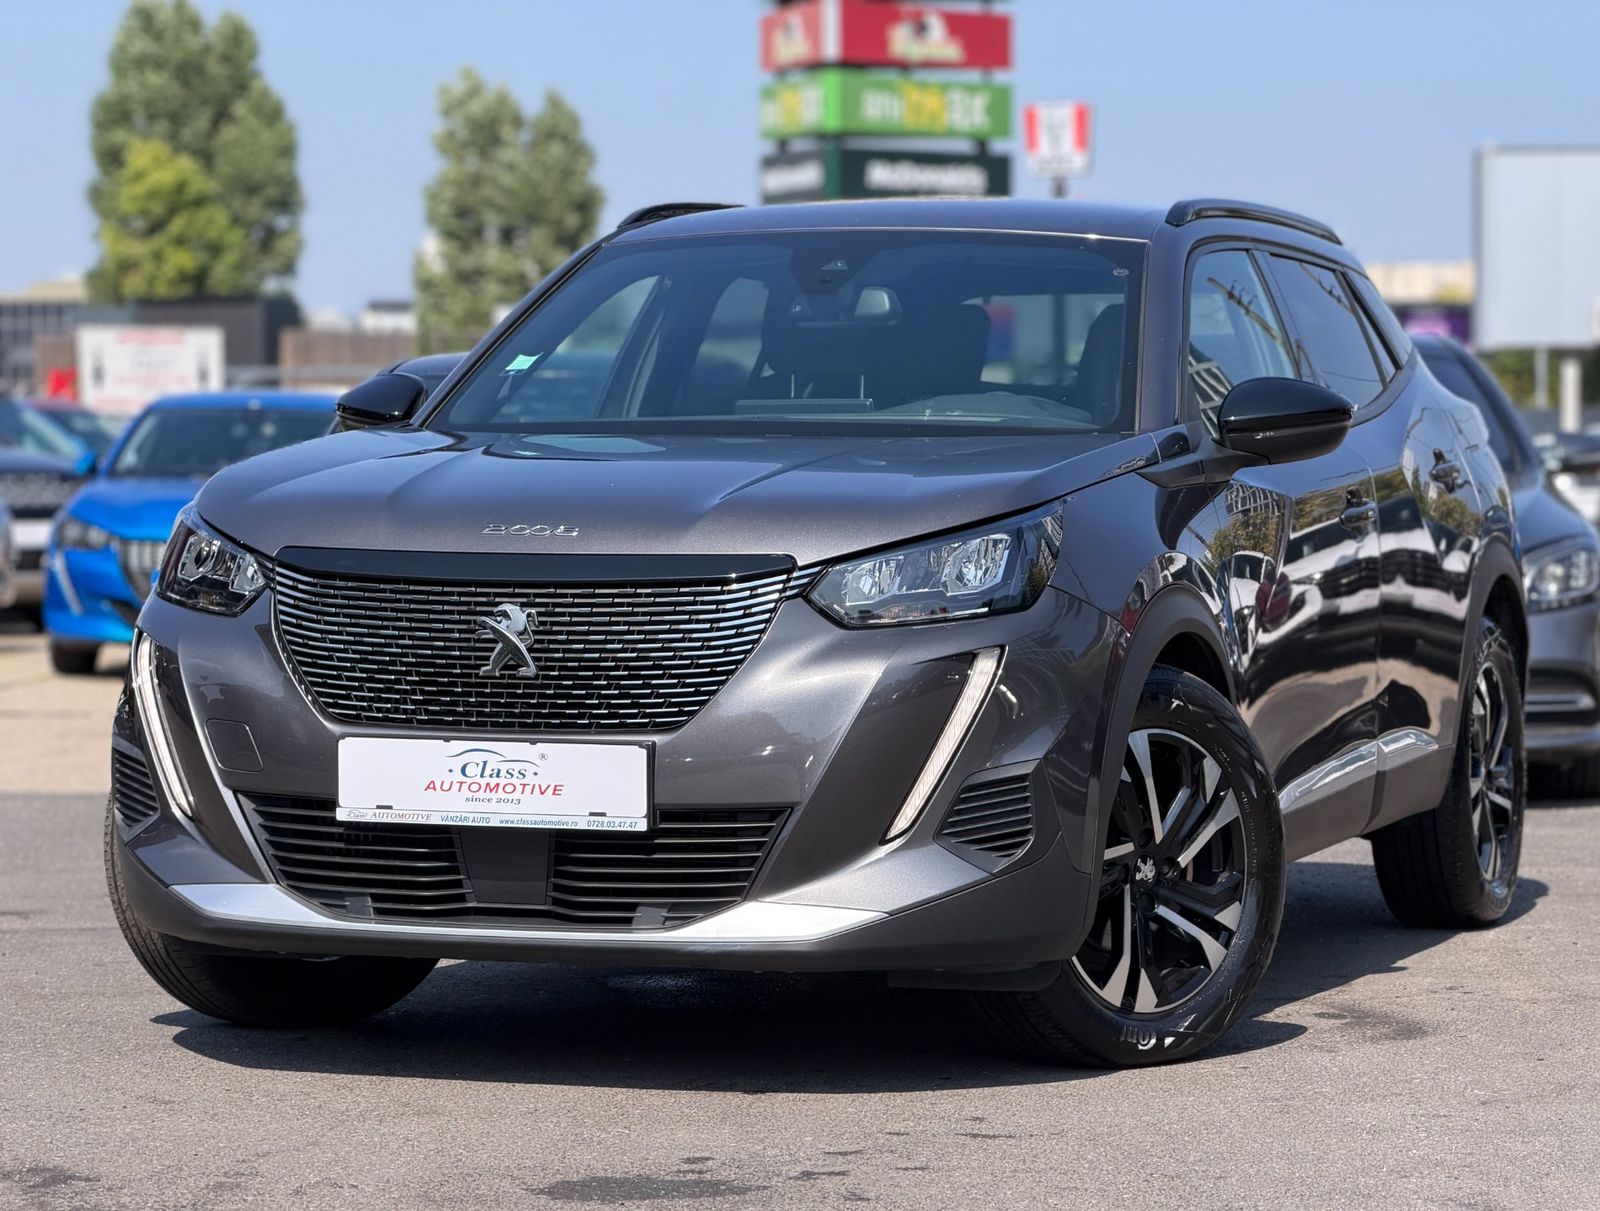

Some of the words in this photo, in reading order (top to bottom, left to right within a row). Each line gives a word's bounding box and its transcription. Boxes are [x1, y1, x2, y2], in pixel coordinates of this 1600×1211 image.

[460, 760, 527, 780] Class
[424, 780, 564, 796] AUTOMOTIVE
[465, 795, 493, 804] since
[495, 798, 521, 806] 2013
[370, 811, 433, 821] AUTOMOTIVE
[471, 816, 491, 825] AUTO
[499, 817, 579, 828] www.classautomotive.ro
[586, 819, 638, 829] 0728.03.47.47
